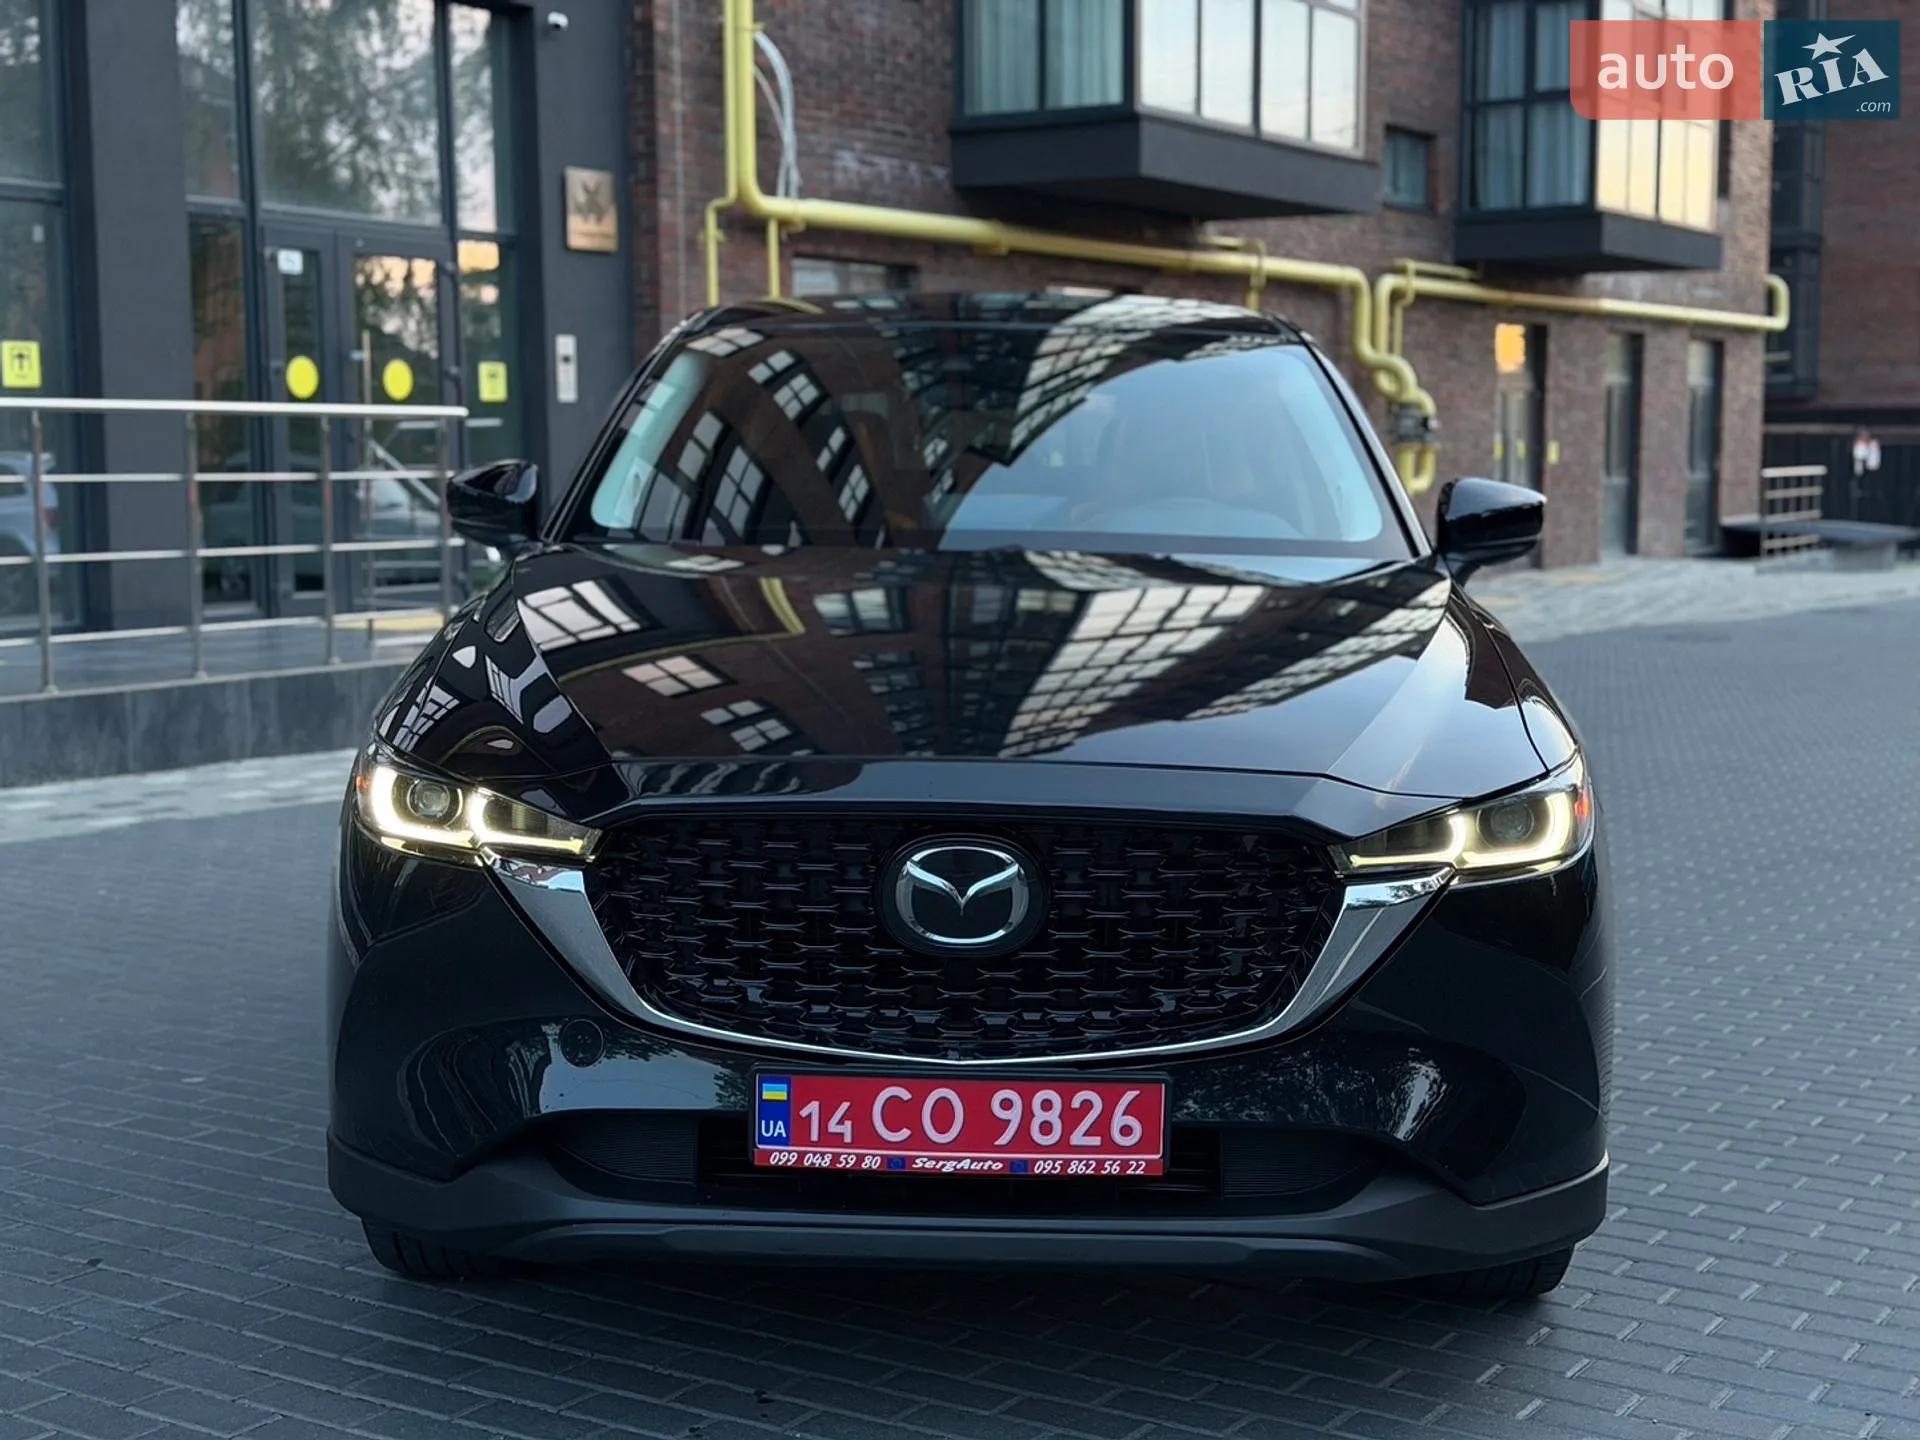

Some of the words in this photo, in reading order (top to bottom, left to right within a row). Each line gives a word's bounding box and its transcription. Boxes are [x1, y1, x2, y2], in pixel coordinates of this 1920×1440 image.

[799, 1100, 853, 1144] 14
[871, 1086, 964, 1144] CO
[990, 1089, 1143, 1147] 9826
[761, 1120, 787, 1138] UA
[769, 1151, 798, 1165] 099
[803, 1153, 832, 1167] 048
[836, 1154, 856, 1168] 59
[861, 1155, 882, 1169] 80
[912, 1157, 1003, 1173] SergAuto
[1034, 1160, 1062, 1174] 095
[1067, 1160, 1095, 1175] 862
[1100, 1160, 1120, 1175] 56
[1126, 1161, 1147, 1175] 22
